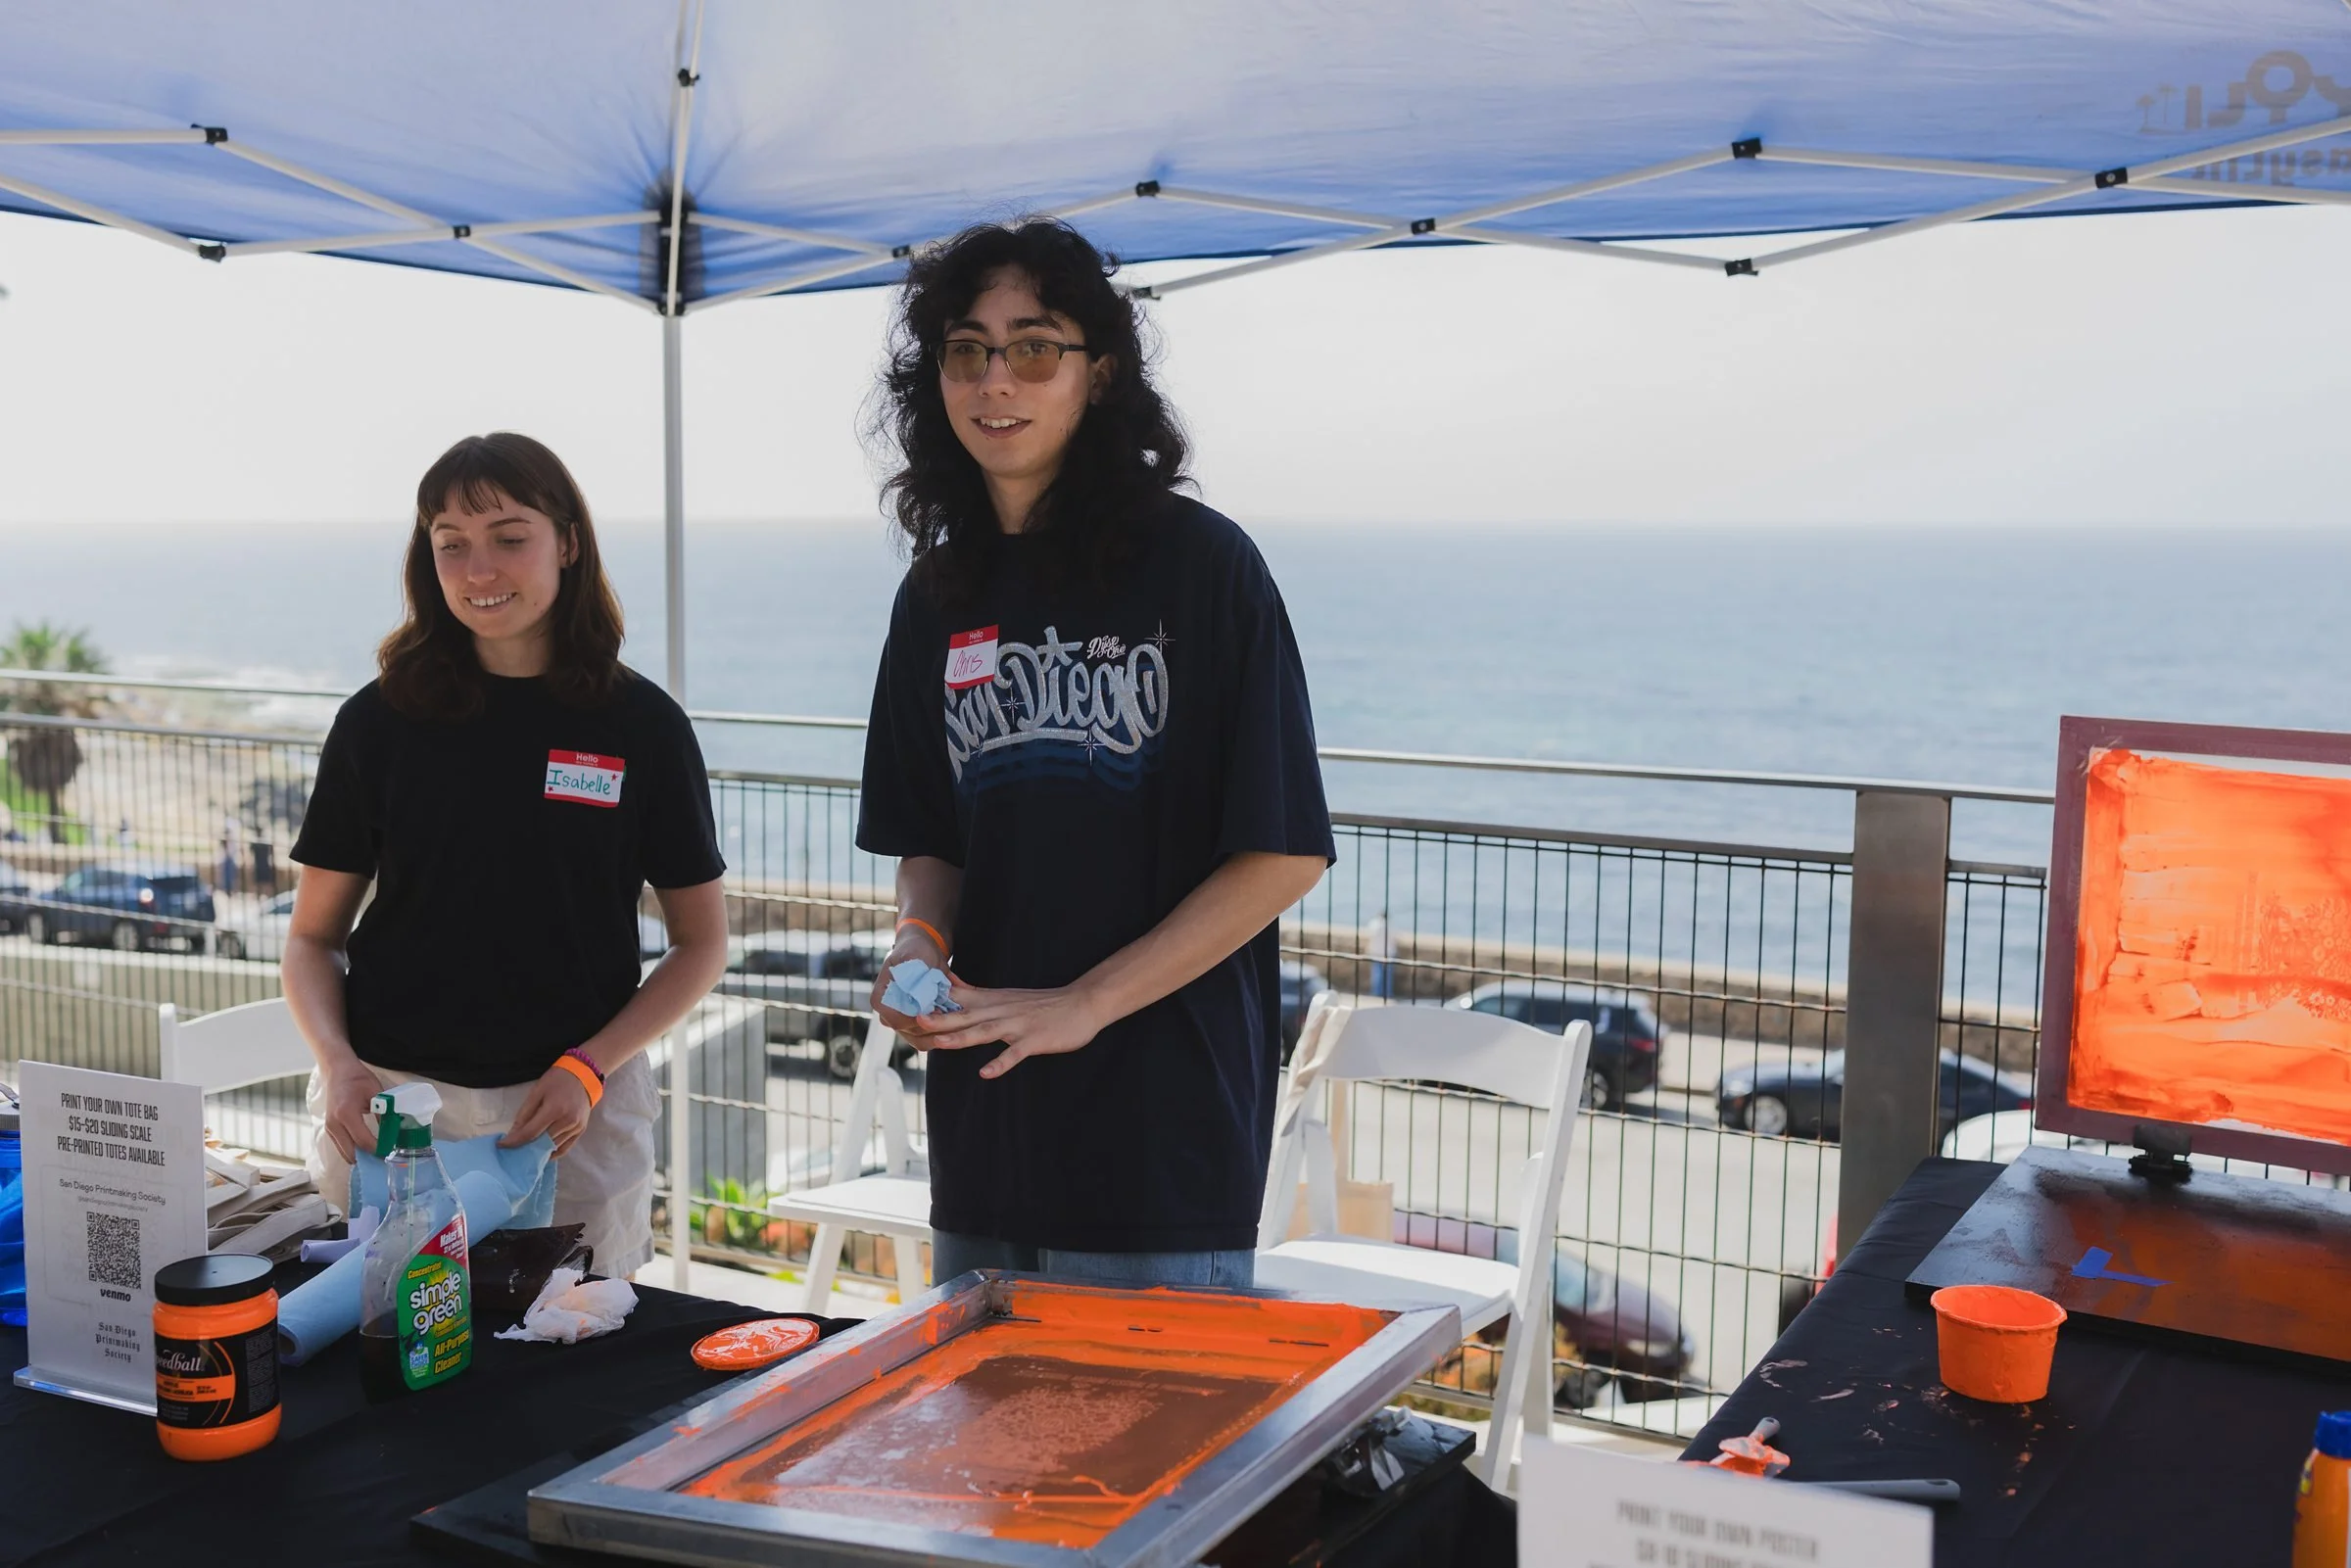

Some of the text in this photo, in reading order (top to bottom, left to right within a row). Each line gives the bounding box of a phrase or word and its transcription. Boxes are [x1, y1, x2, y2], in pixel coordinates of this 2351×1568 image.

[968, 631, 984, 641] Hello
[953, 649, 984, 678] Chris
[994, 626, 1169, 754] Diego
[576, 752, 599, 764] Hello
[547, 769, 611, 795] Isabelle
[61, 1092, 159, 1121] PRINT YOUR OWN TOTE BAG
[100, 1119, 128, 1139] SLIDING
[129, 1124, 153, 1143] SCALE
[57, 1135, 166, 1166] PRE-PRINTED TOTES AVAILABLE
[60, 1178, 167, 1207] San Diego Printmaking Society
[100, 1288, 132, 1303] venmo
[409, 1270, 461, 1309] simple
[413, 1294, 462, 1336] green
[95, 1333, 140, 1353] Printmaking
[99, 1321, 136, 1339] San Diego
[434, 1329, 470, 1357] All-Purpose
[105, 1348, 131, 1363] Society
[434, 1352, 462, 1374] Cleaner
